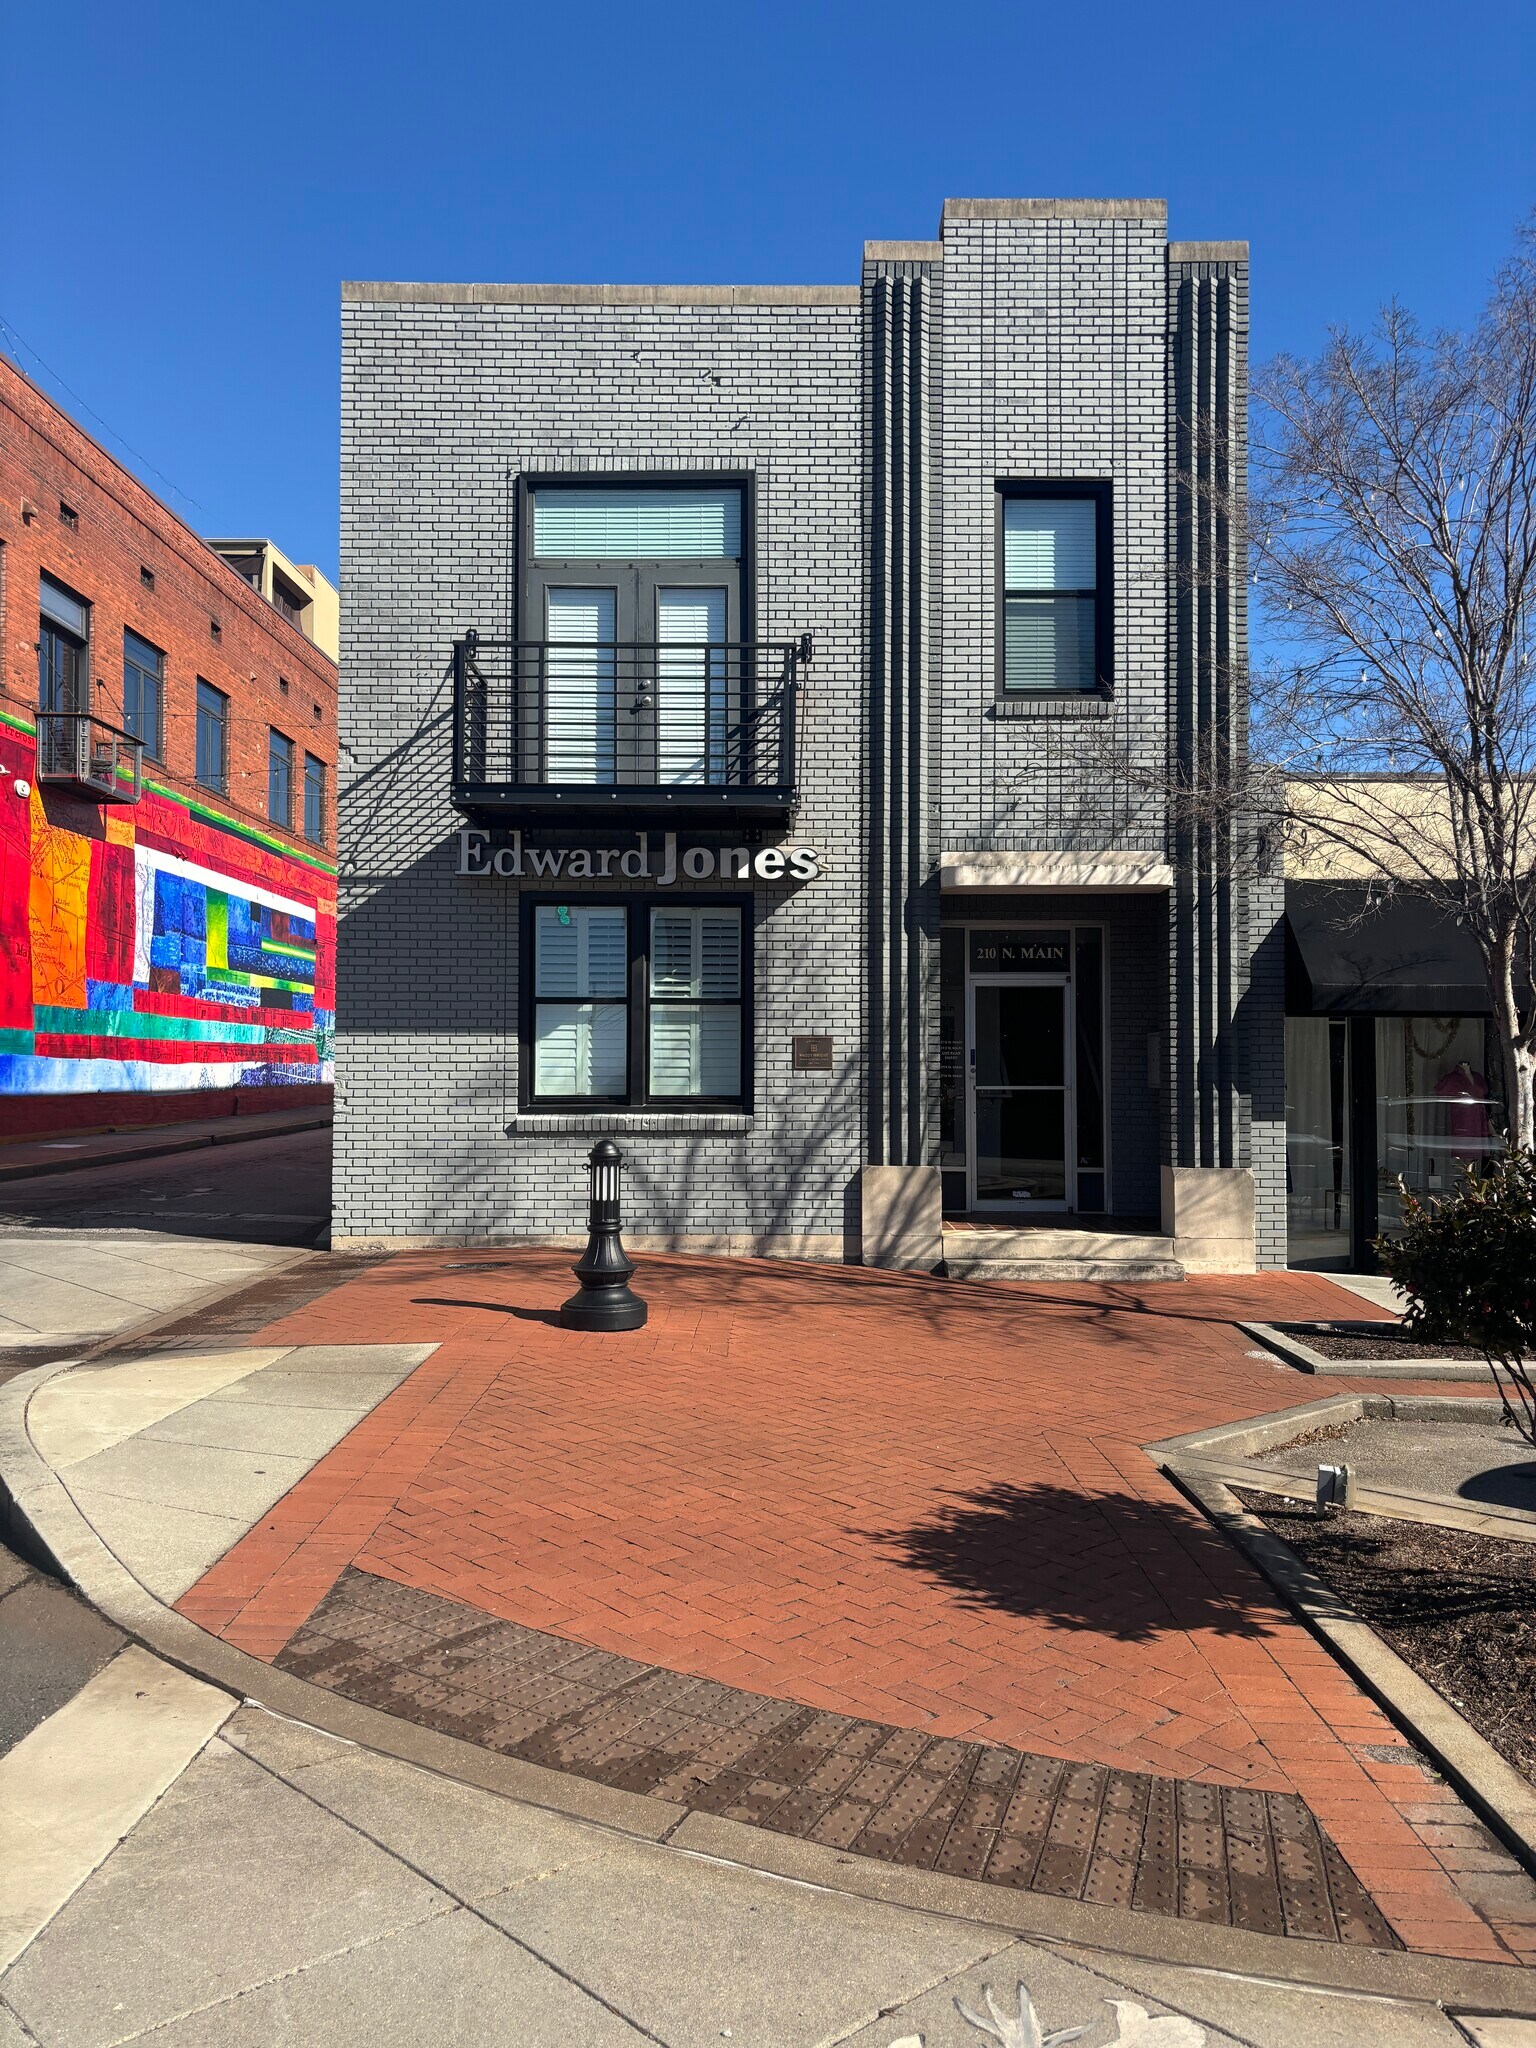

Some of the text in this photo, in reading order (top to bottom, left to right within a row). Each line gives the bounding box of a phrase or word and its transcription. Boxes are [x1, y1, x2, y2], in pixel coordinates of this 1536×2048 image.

[454, 829, 819, 885] Edward Jones
[976, 947, 1064, 959] 210 N. MAIN
